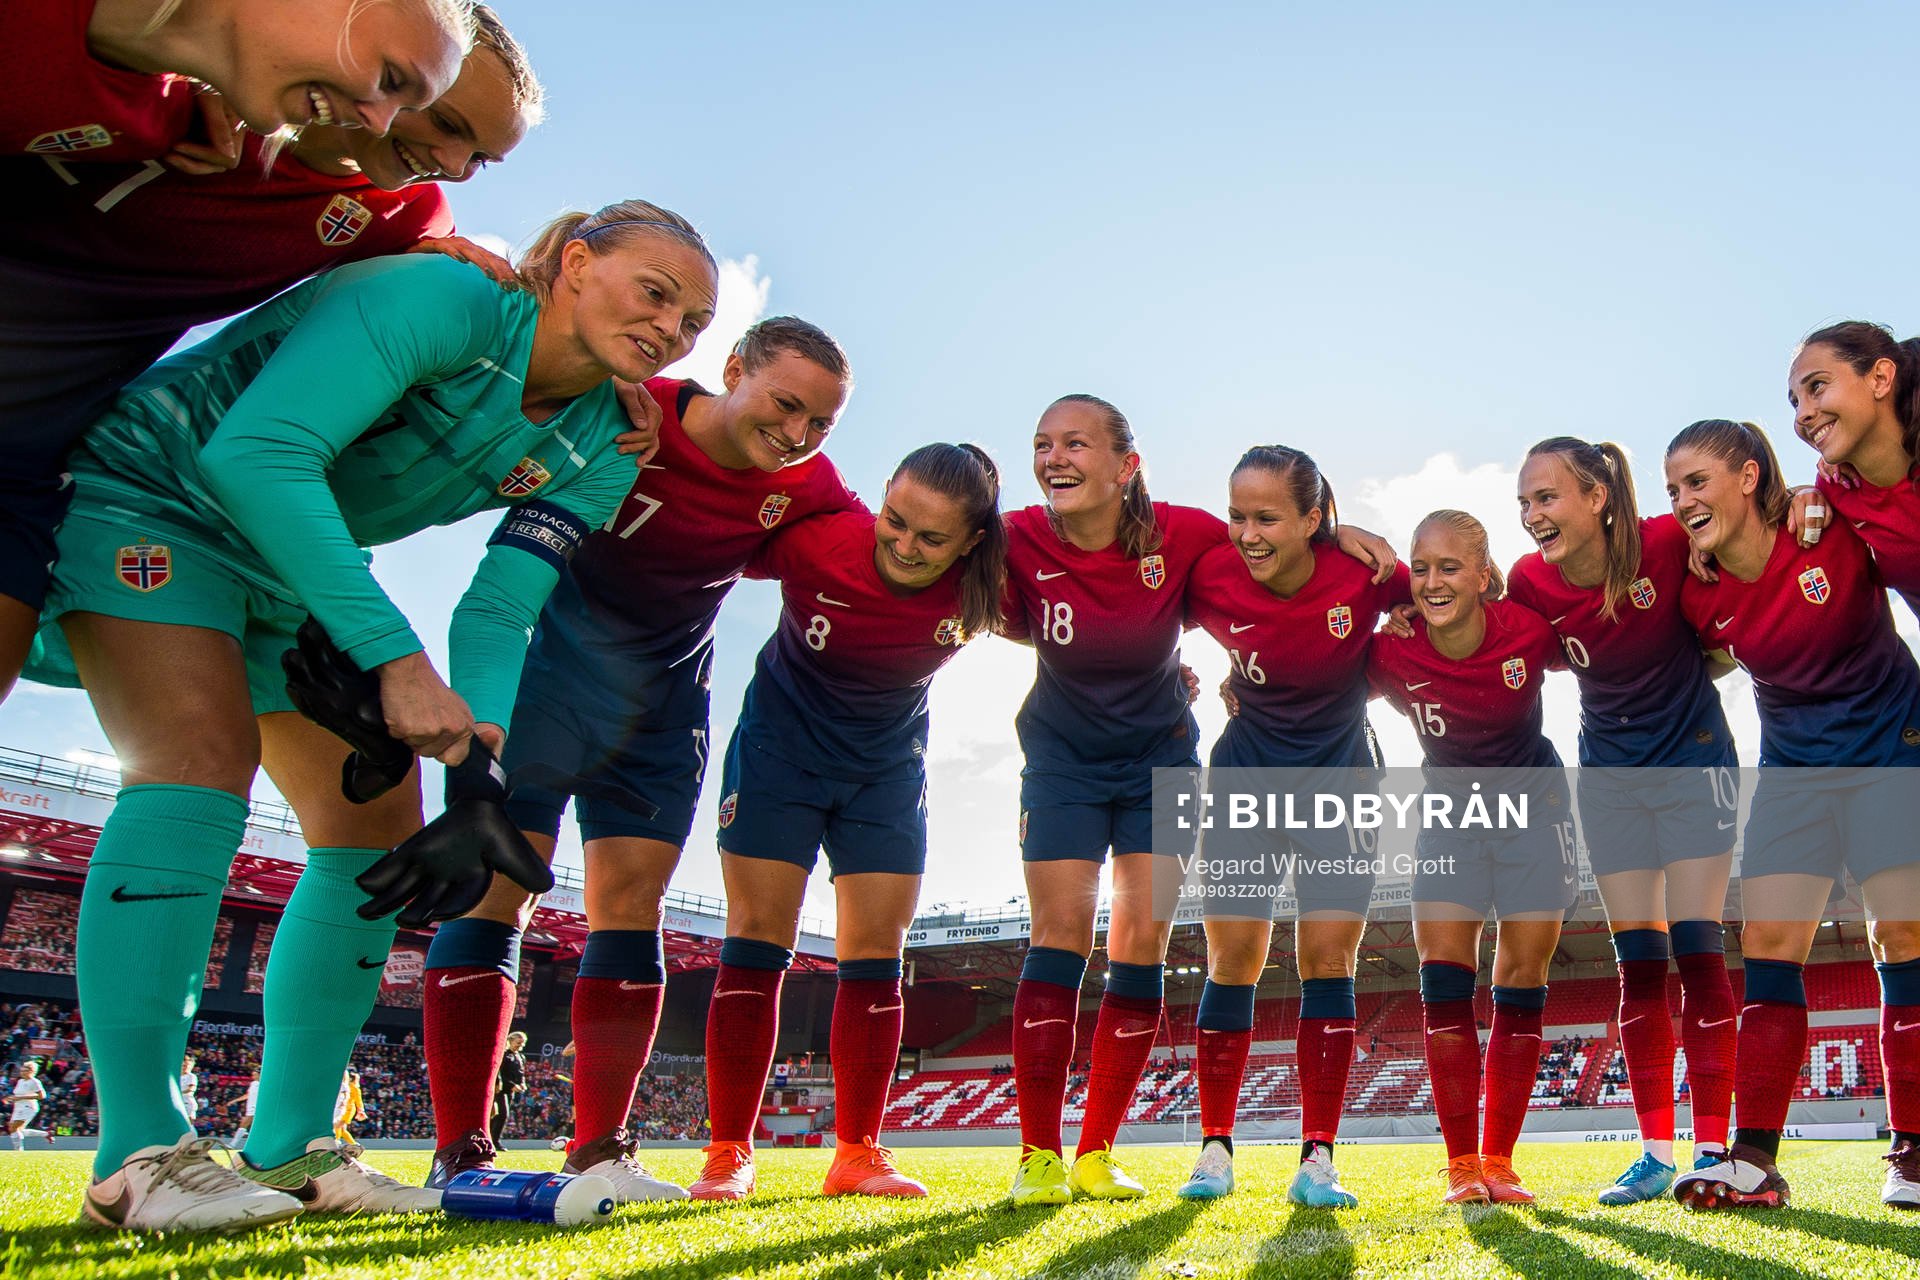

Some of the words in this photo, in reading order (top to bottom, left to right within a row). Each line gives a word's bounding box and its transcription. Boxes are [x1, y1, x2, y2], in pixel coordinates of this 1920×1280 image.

[516, 523, 567, 551] RESPECT
[541, 513, 580, 541] RACISM
[806, 614, 831, 651] 8
[1041, 598, 1073, 646] 18
[1230, 649, 1266, 685] 16
[1411, 702, 1446, 737] 15
[1703, 766, 1738, 811] 10
[1551, 821, 1575, 866] 15
[194, 1020, 265, 1036] Fjordkraft
[1622, 1133, 1638, 1142] UP
